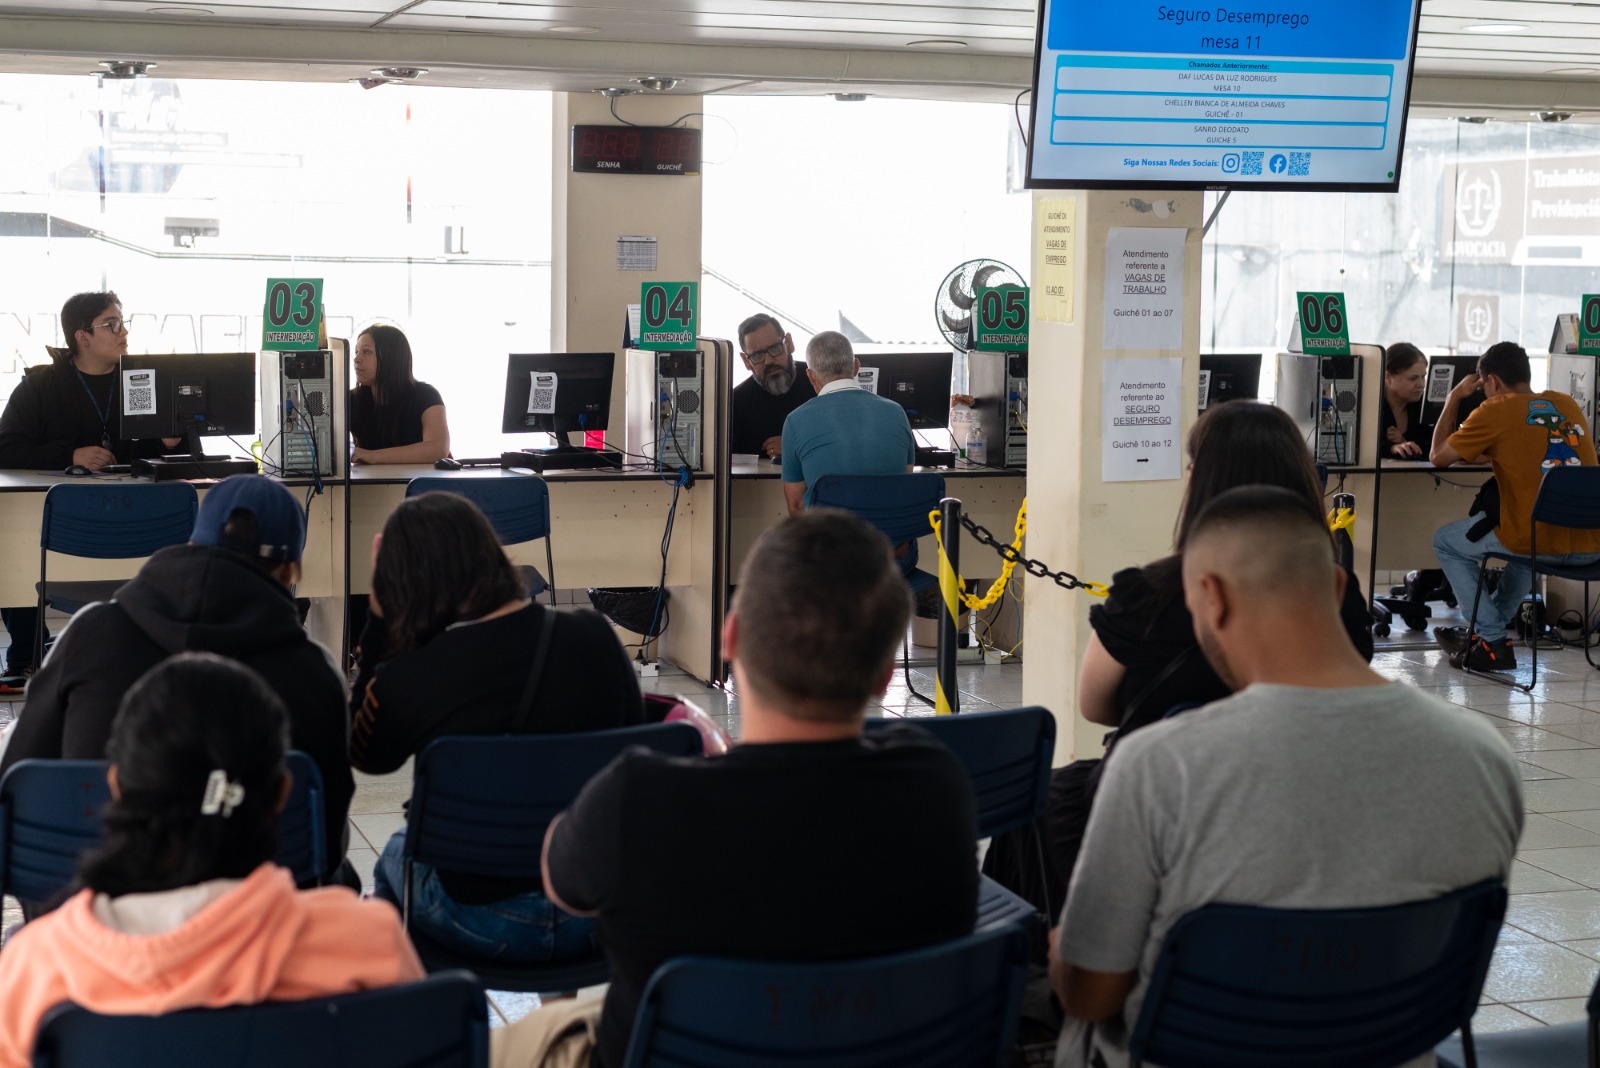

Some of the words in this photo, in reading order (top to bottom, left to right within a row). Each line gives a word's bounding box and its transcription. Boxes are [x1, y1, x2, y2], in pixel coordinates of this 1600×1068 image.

[1158, 6, 1211, 25] Seguro
[1216, 8, 1309, 29] Desemprego
[1201, 37, 1239, 49] mesa
[1246, 36, 1261, 49] 11
[1188, 61, 1221, 69] Chamados
[1222, 62, 1270, 70] Anteriormente:
[1194, 99, 1219, 107] BIANCA
[596, 161, 621, 169] SENHA
[1123, 158, 1140, 167] Siga
[1141, 158, 1167, 167] Nossas
[1169, 159, 1191, 167] Redes
[1192, 159, 1220, 168] Sociais:
[1043, 225, 1071, 234] ATENDIMENTO
[1045, 240, 1060, 248] VAGAS
[1061, 240, 1067, 248] DE
[1122, 250, 1169, 258] Atendimento
[1045, 255, 1067, 264] EMPREGO
[1125, 262, 1159, 270] referente
[1124, 273, 1153, 282] VAGAS
[1154, 273, 1166, 282] DE
[1122, 285, 1167, 294] TRABALHO
[269, 281, 316, 327] 03
[645, 285, 693, 328] 04
[981, 290, 1027, 330] 05
[1141, 309, 1150, 317] 01
[1164, 309, 1174, 317] 07
[1302, 294, 1343, 334] 06
[266, 329, 315, 344] INTERMEDIAÇÃO
[644, 330, 693, 344] INTERMEDIAÇÃO
[981, 333, 1027, 345] INTERMEDIAÇÃO
[1305, 337, 1347, 350] INTERMEDIAÇÃO
[1120, 382, 1166, 390] Atendimento
[1121, 394, 1154, 402] referente
[1125, 405, 1160, 414] SEGURO
[1113, 416, 1172, 426] DESEMPREGO
[1141, 440, 1150, 448] 10
[1163, 439, 1172, 447] 12
